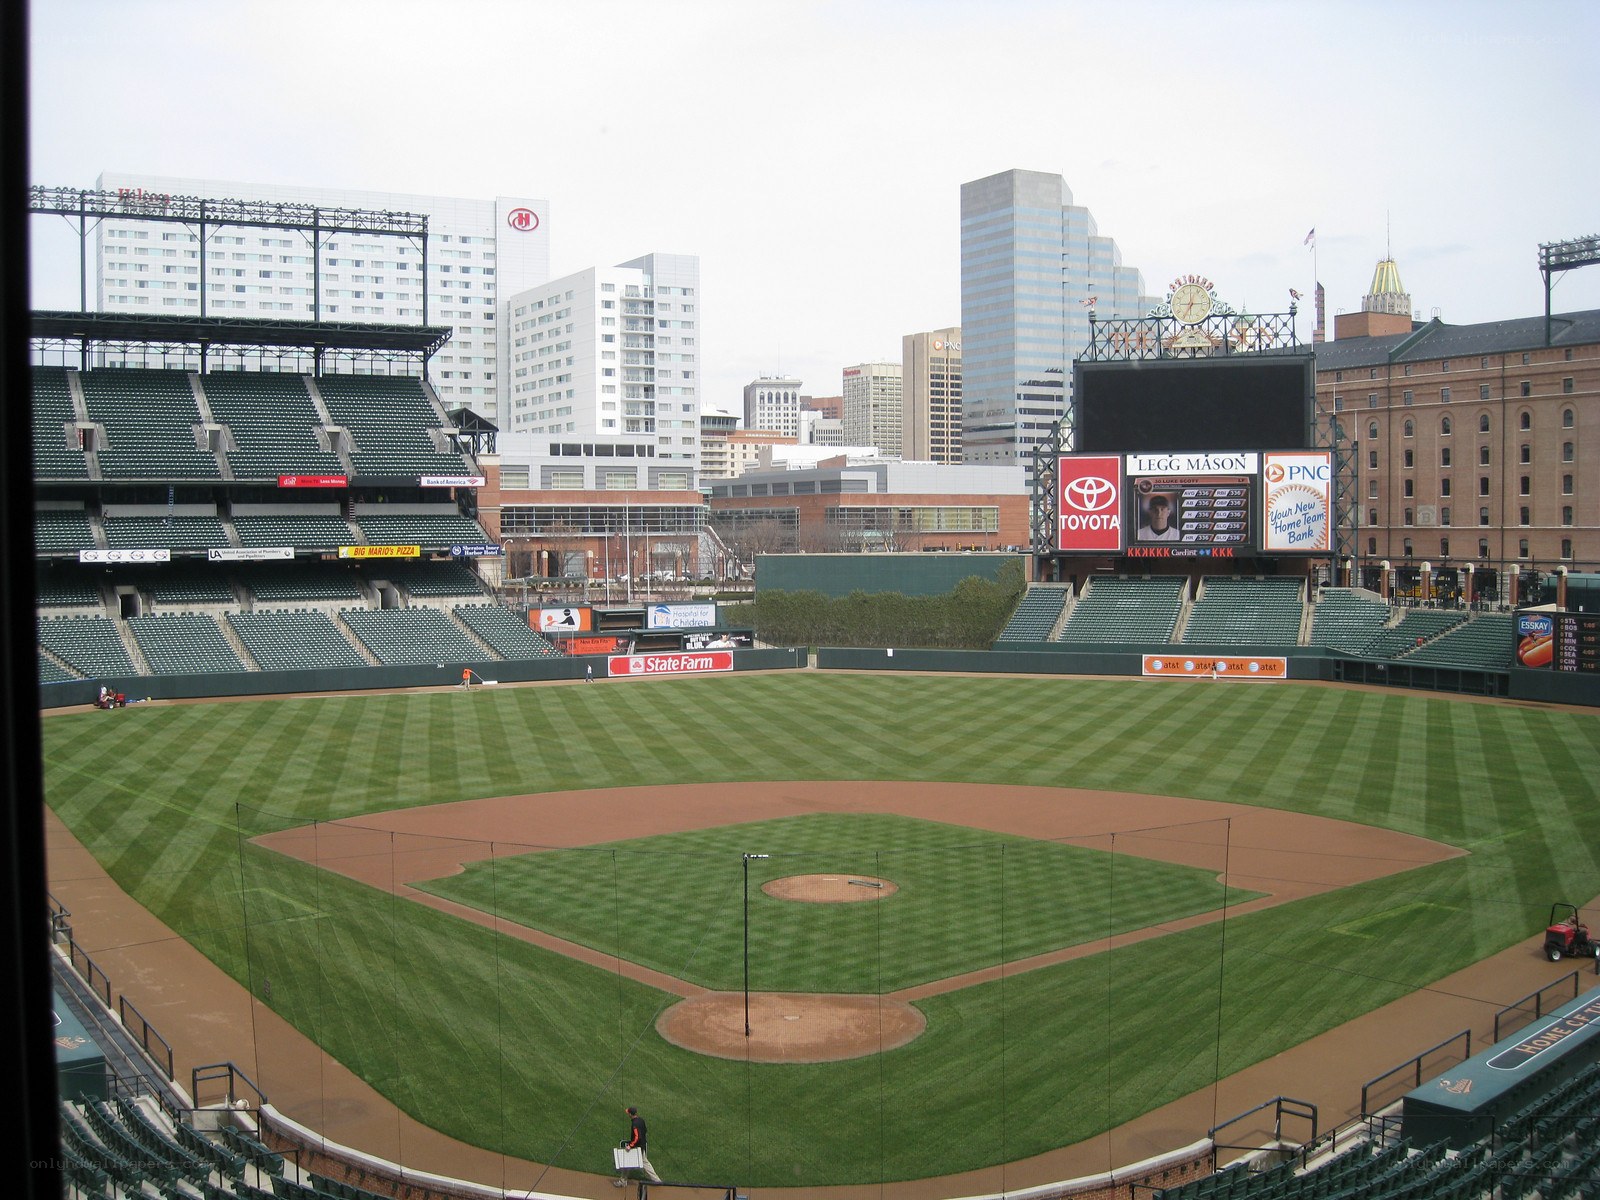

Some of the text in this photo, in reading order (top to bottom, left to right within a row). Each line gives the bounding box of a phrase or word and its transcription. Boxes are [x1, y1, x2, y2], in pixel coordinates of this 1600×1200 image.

[1109, 330, 1156, 351] THE
[1229, 326, 1276, 347] SUN
[1137, 456, 1247, 471] LEGG MASON
[1289, 465, 1330, 480] PNC
[1270, 501, 1316, 527] Your New
[1059, 514, 1121, 531] TOYOTA
[1275, 512, 1325, 535] Home Team
[1288, 527, 1314, 544] Bank
[209, 550, 222, 559] UA
[353, 547, 366, 556] BIG
[396, 546, 415, 555] PIZZA
[673, 610, 699, 619] Hospital
[673, 618, 709, 627] Children
[1521, 621, 1549, 631] ESSKAY
[646, 655, 713, 672] State Farm
[1163, 661, 1180, 669] at&t
[1227, 662, 1244, 670] at&t
[1260, 663, 1276, 671] at&t
[1515, 1027, 1573, 1055] HOME
[1565, 1014, 1591, 1028] OF
